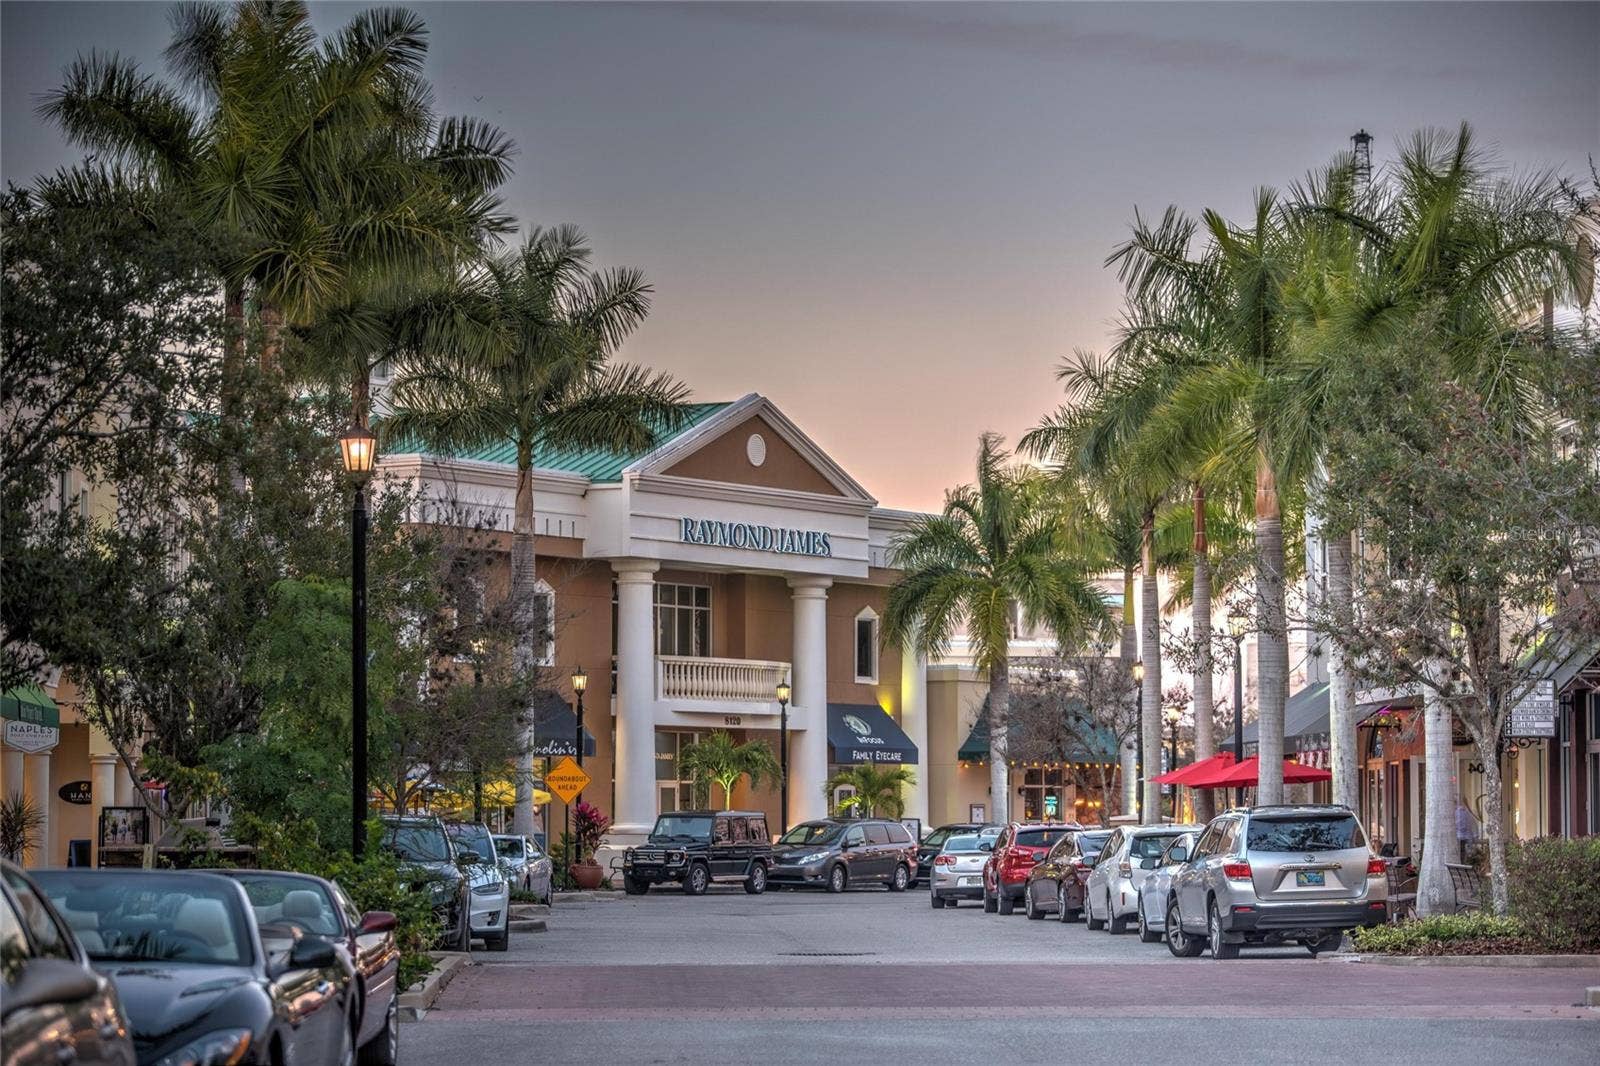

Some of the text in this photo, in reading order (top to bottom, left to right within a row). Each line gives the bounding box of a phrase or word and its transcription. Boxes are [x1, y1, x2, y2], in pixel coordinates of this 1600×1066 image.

[681, 517, 832, 558] RAYMOND JAMES
[10, 725, 53, 734] NAPLES
[852, 750, 902, 761] FAMILY EYECARE
[548, 775, 586, 783] ROUNDABOUT
